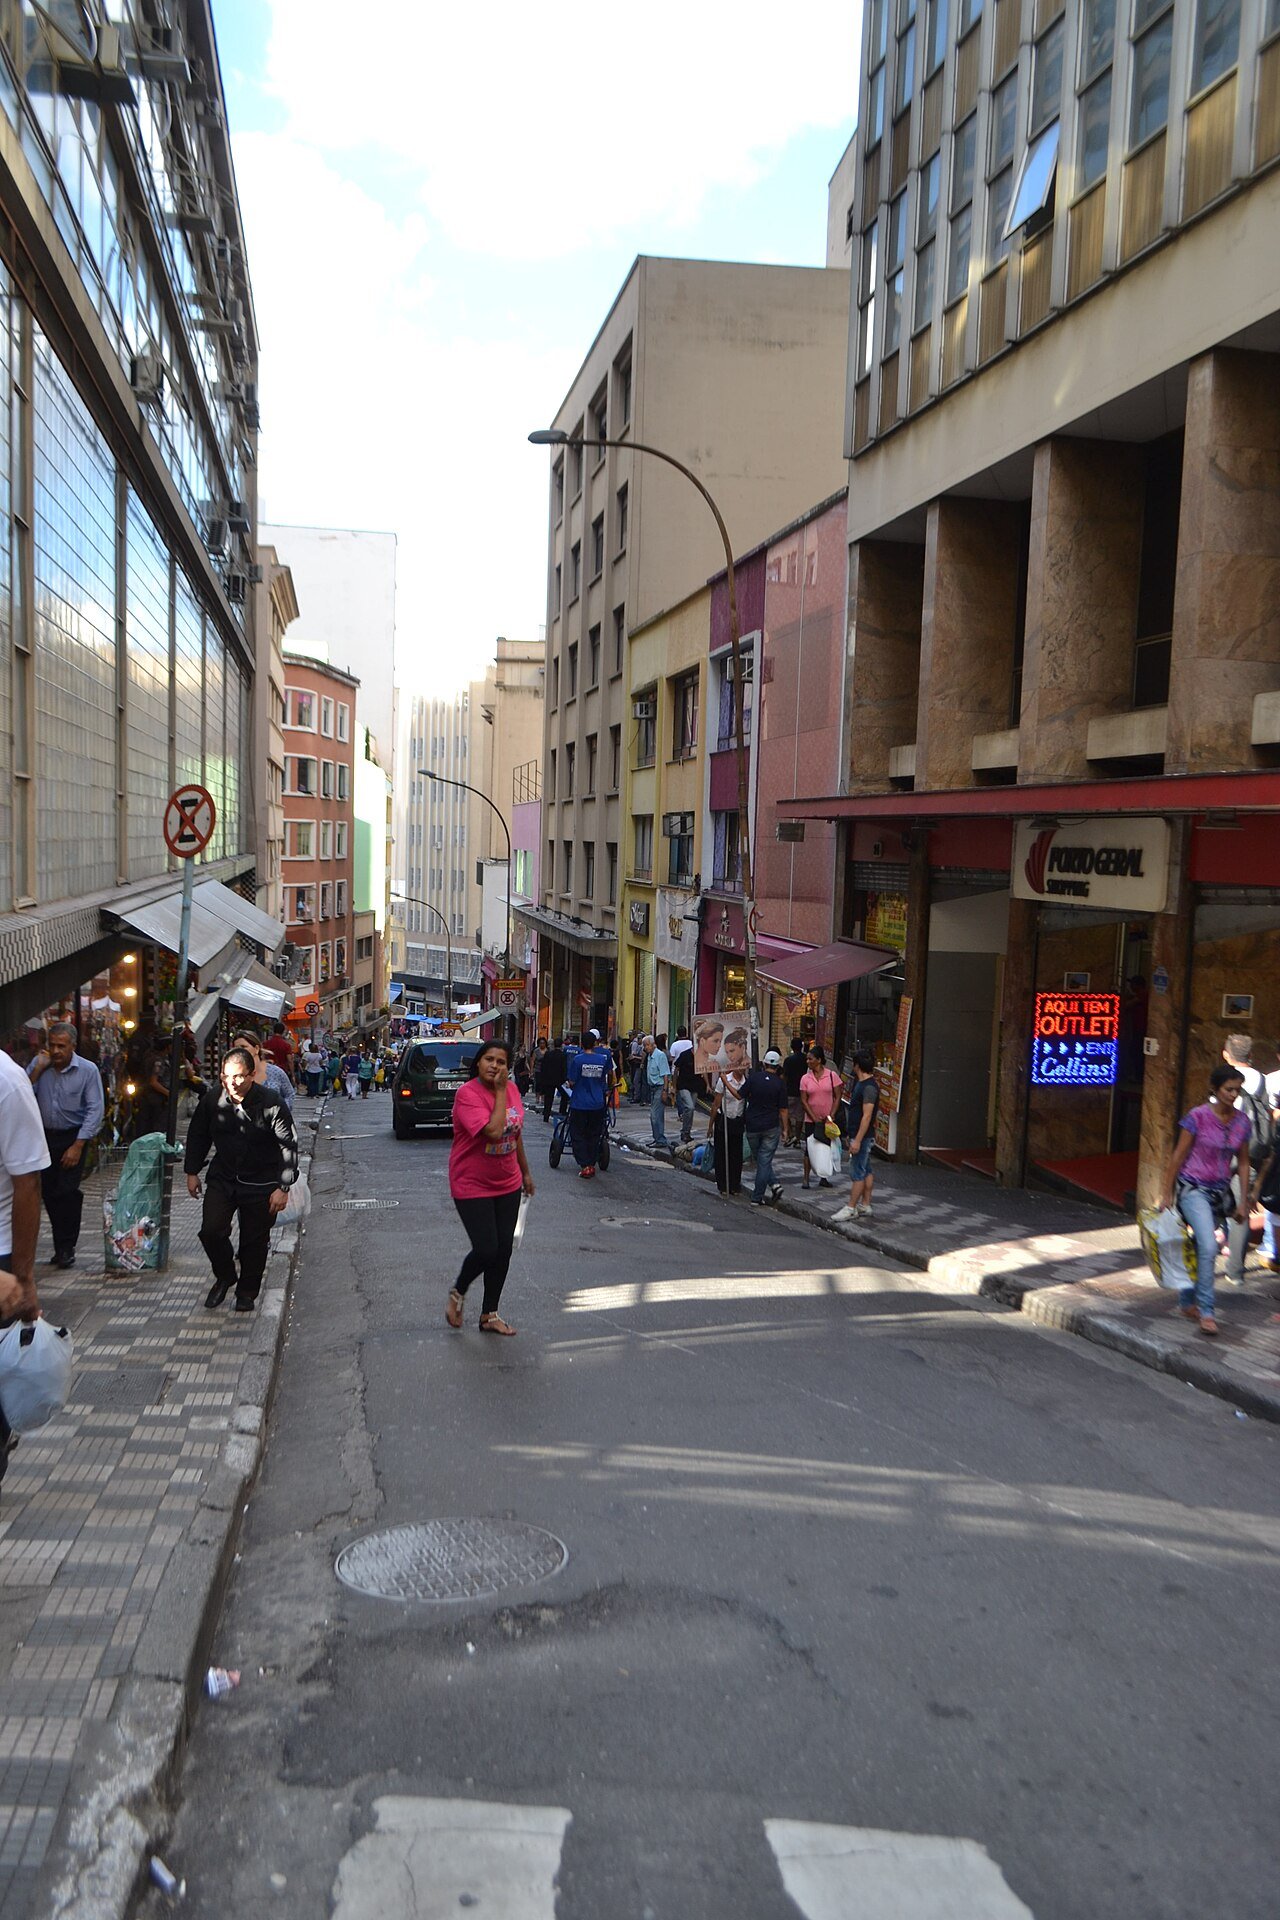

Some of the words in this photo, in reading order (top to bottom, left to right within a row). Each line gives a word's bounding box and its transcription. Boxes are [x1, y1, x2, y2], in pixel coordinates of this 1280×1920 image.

[1048, 846, 1094, 874] PORTO
[1095, 847, 1144, 877] GERAL
[1044, 1000, 1079, 1015] AQUI
[1083, 1001, 1110, 1014] TEM
[1040, 1015, 1115, 1035] OUTLET
[1040, 1057, 1110, 1077] Collins
